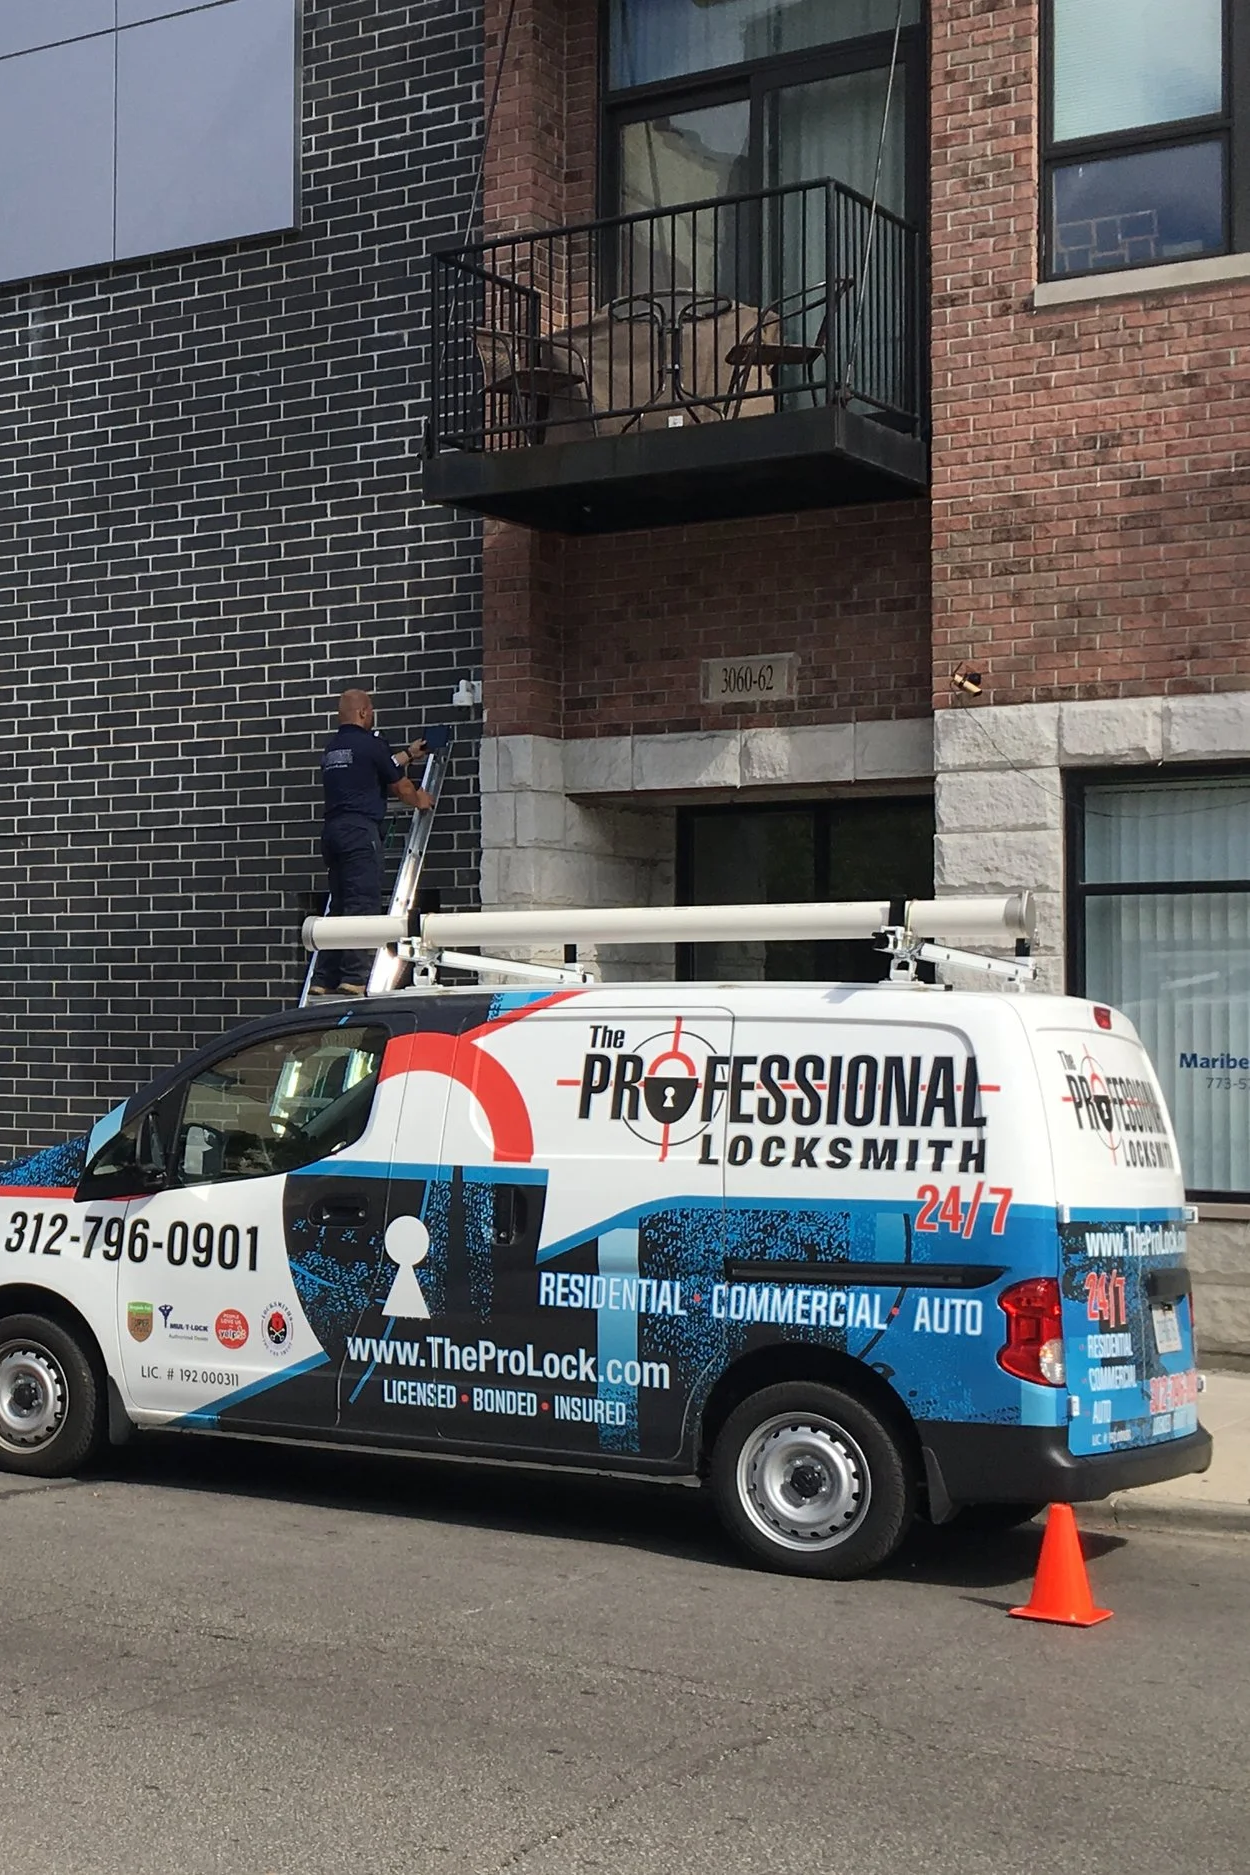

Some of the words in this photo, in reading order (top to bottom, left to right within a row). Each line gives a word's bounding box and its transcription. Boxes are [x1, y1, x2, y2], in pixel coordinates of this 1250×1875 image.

[721, 665, 774, 693] 3060-62
[590, 1025, 625, 1049] The
[1057, 1050, 1077, 1071] The
[577, 1052, 988, 1127] PROFESSIONAL
[698, 1134, 986, 1173] LOCKSMITH
[914, 1181, 1014, 1239] 24/7
[4, 1210, 260, 1272] 312-796-0901
[538, 1271, 687, 1316] RESIDENTIAL
[712, 1284, 888, 1330] COMMERCIAL
[913, 1297, 983, 1336] AUTO
[1083, 1267, 1127, 1329] 24/7
[141, 1365, 163, 1381] LIC.
[167, 1368, 174, 1381] #
[179, 1367, 240, 1387] 192.000311
[347, 1336, 670, 1390] www.TheProLock.com
[383, 1379, 457, 1409] LICENSED
[472, 1388, 538, 1417] BONDED
[554, 1395, 627, 1427] INSURED
